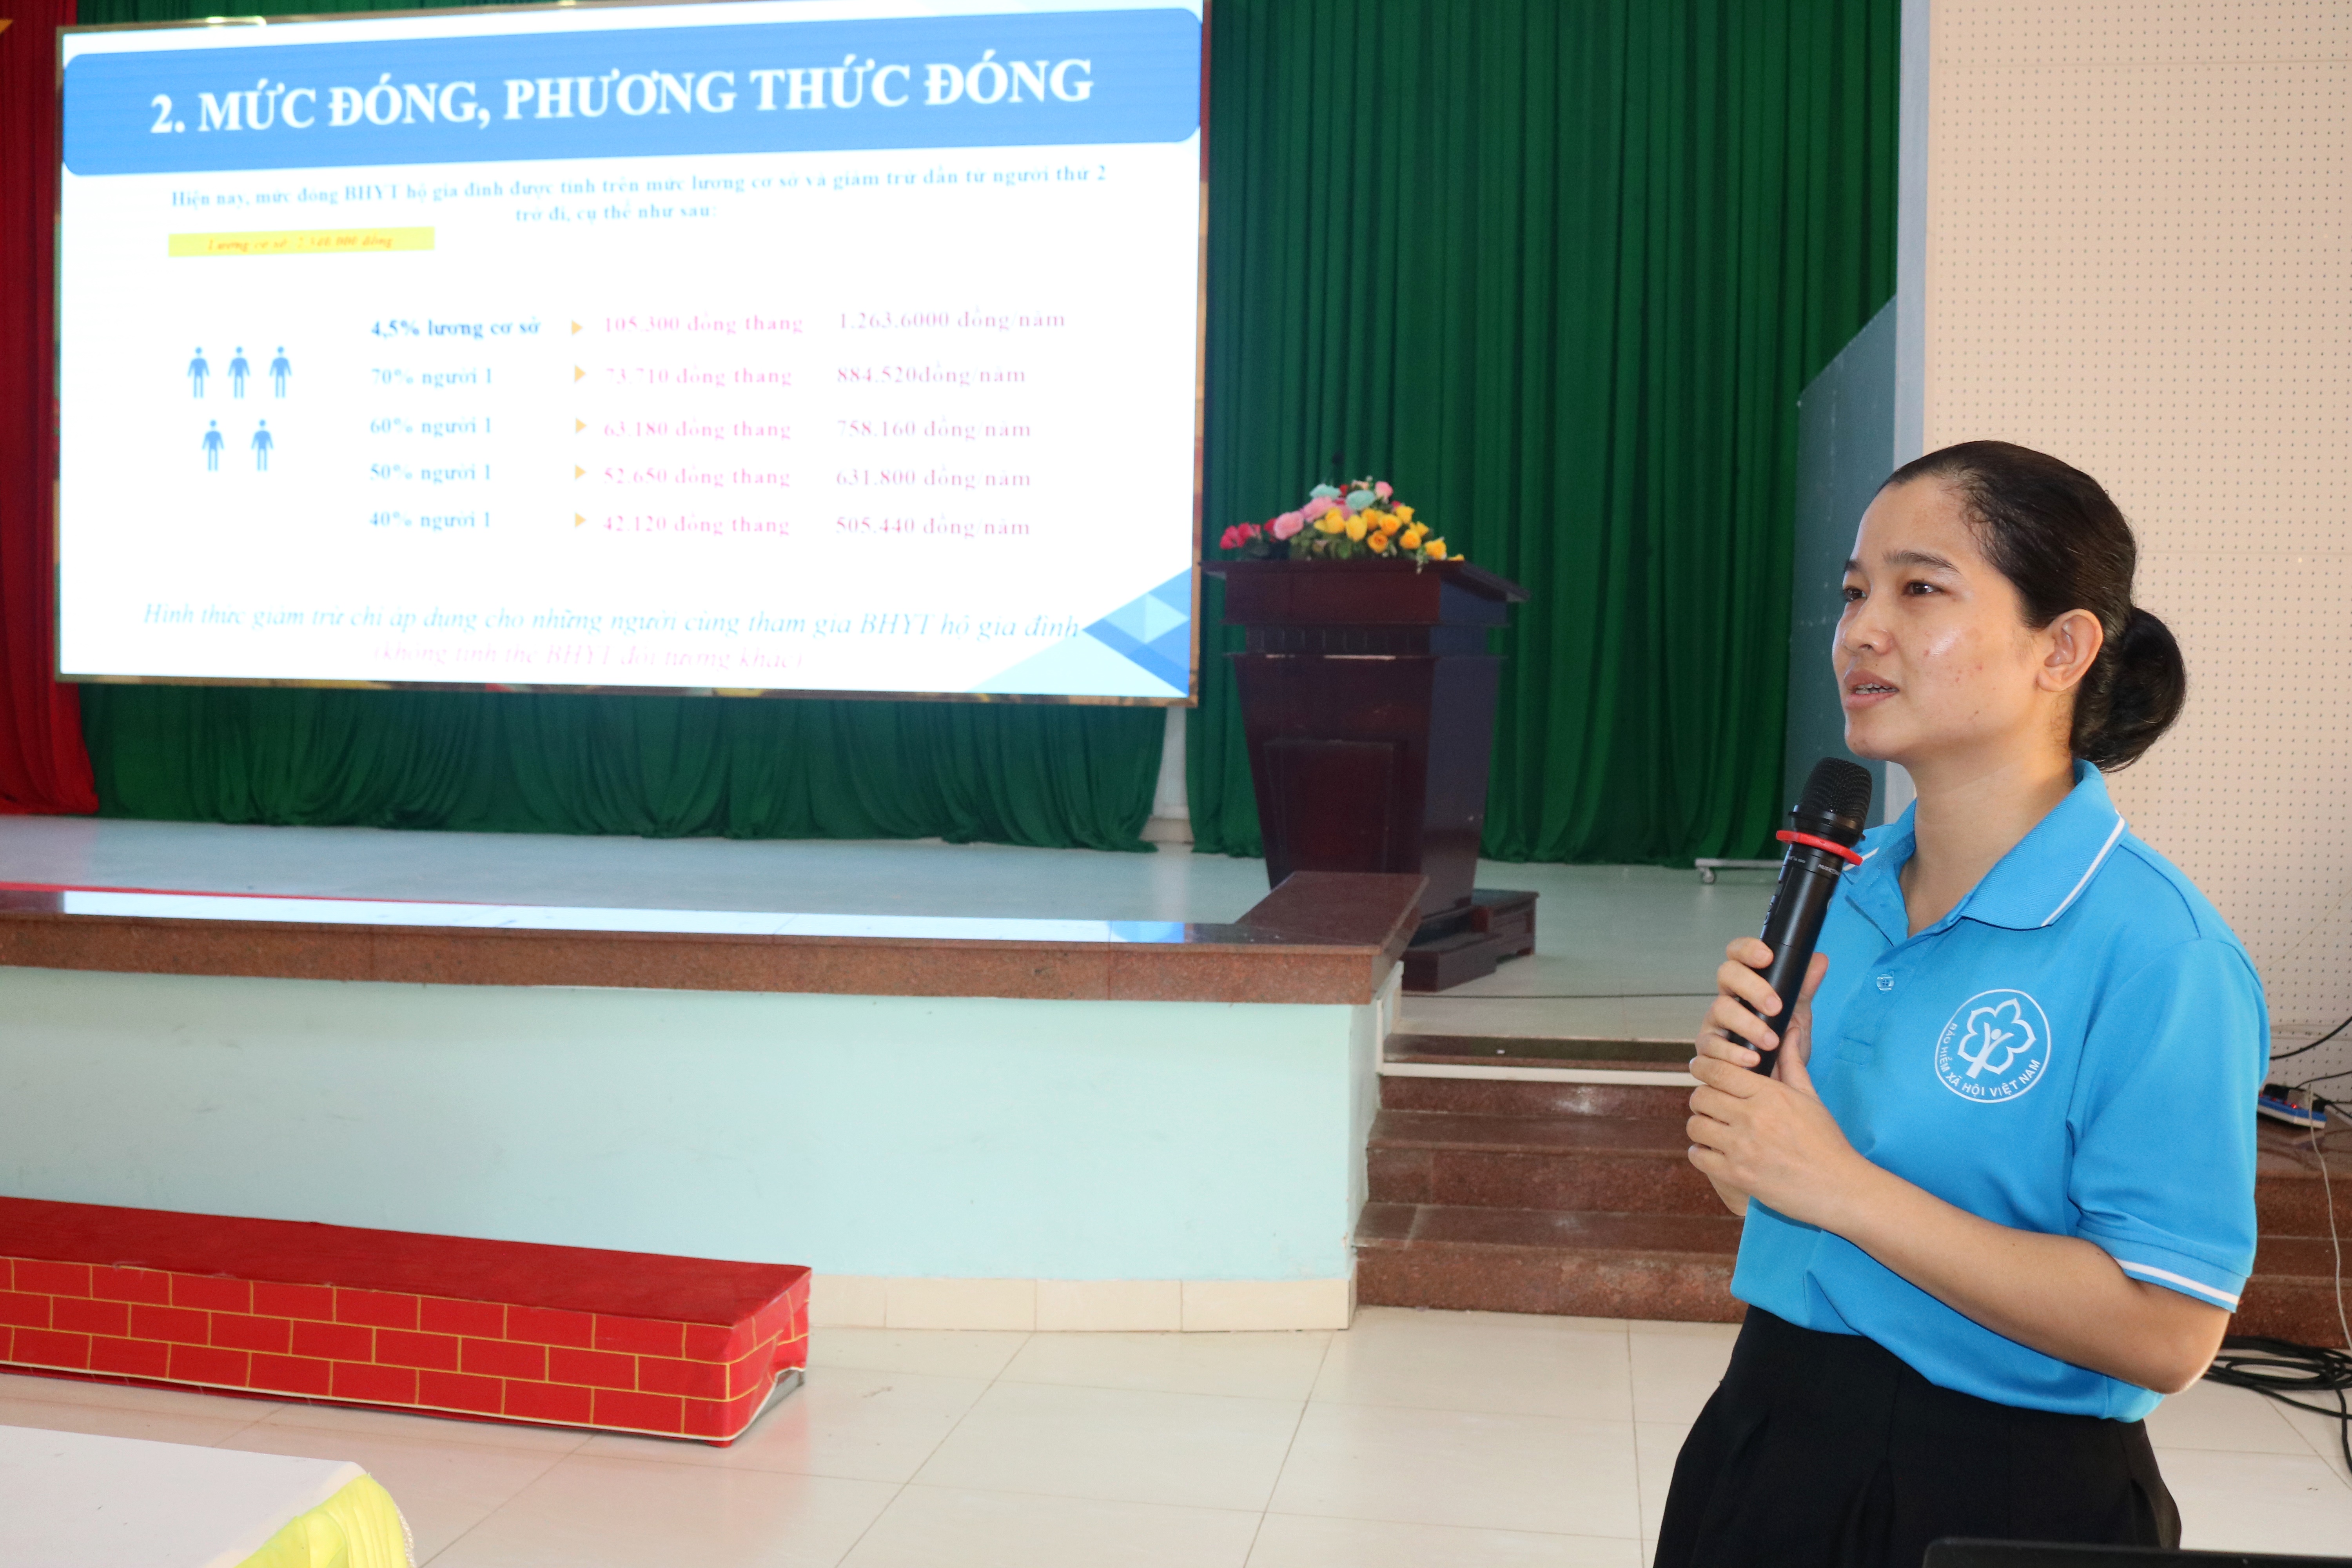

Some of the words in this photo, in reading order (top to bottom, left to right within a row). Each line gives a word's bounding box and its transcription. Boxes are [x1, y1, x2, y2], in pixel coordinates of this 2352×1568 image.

[151, 95, 185, 133] 2.
[199, 79, 316, 131] MỨC
[328, 73, 490, 129] ĐÓNG,
[505, 68, 737, 119] PHƯƠNG
[750, 54, 910, 110] THỨC
[924, 49, 1094, 105] ĐÓNG
[172, 190, 210, 210] Hiện
[216, 194, 250, 209] nay,
[255, 189, 291, 204] mức
[345, 184, 401, 201] BHYT
[406, 183, 427, 203] hộ
[432, 182, 458, 203] gia
[509, 180, 554, 200] được
[602, 176, 639, 193] trên
[646, 178, 684, 192] mức
[692, 174, 745, 194] lương
[751, 178, 773, 189] cơ
[1097, 164, 1106, 181] 2
[548, 205, 571, 223] đi,
[576, 209, 597, 225] cụ
[638, 203, 675, 219] như
[680, 206, 717, 218] sau:
[371, 319, 420, 339] 4,5%
[428, 318, 484, 341] lương
[490, 322, 514, 336] cơ
[371, 368, 414, 385] 70%
[486, 367, 492, 385] 1
[369, 417, 414, 434] 60%
[485, 416, 491, 434] 1
[838, 420, 915, 437] 758.160
[370, 463, 413, 480] 50%
[485, 463, 490, 481] 1
[837, 469, 915, 485] 631.800
[369, 511, 412, 528] 40%
[484, 511, 490, 528] 1
[837, 517, 915, 533] 505.440
[485, 607, 524, 628] cho
[748, 610, 806, 633] tham
[812, 614, 852, 639] gia
[860, 613, 935, 635] BHYT
[940, 613, 970, 639] hộ
[976, 616, 1016, 642] gia
[1940, 1046, 1953, 1073] HIỂM
[1945, 1072, 1963, 1087] XÃ
[2018, 1059, 2040, 1084] NAM
[1961, 1083, 1985, 1097] HỘI
[1989, 1080, 2018, 1097] VIỆT
